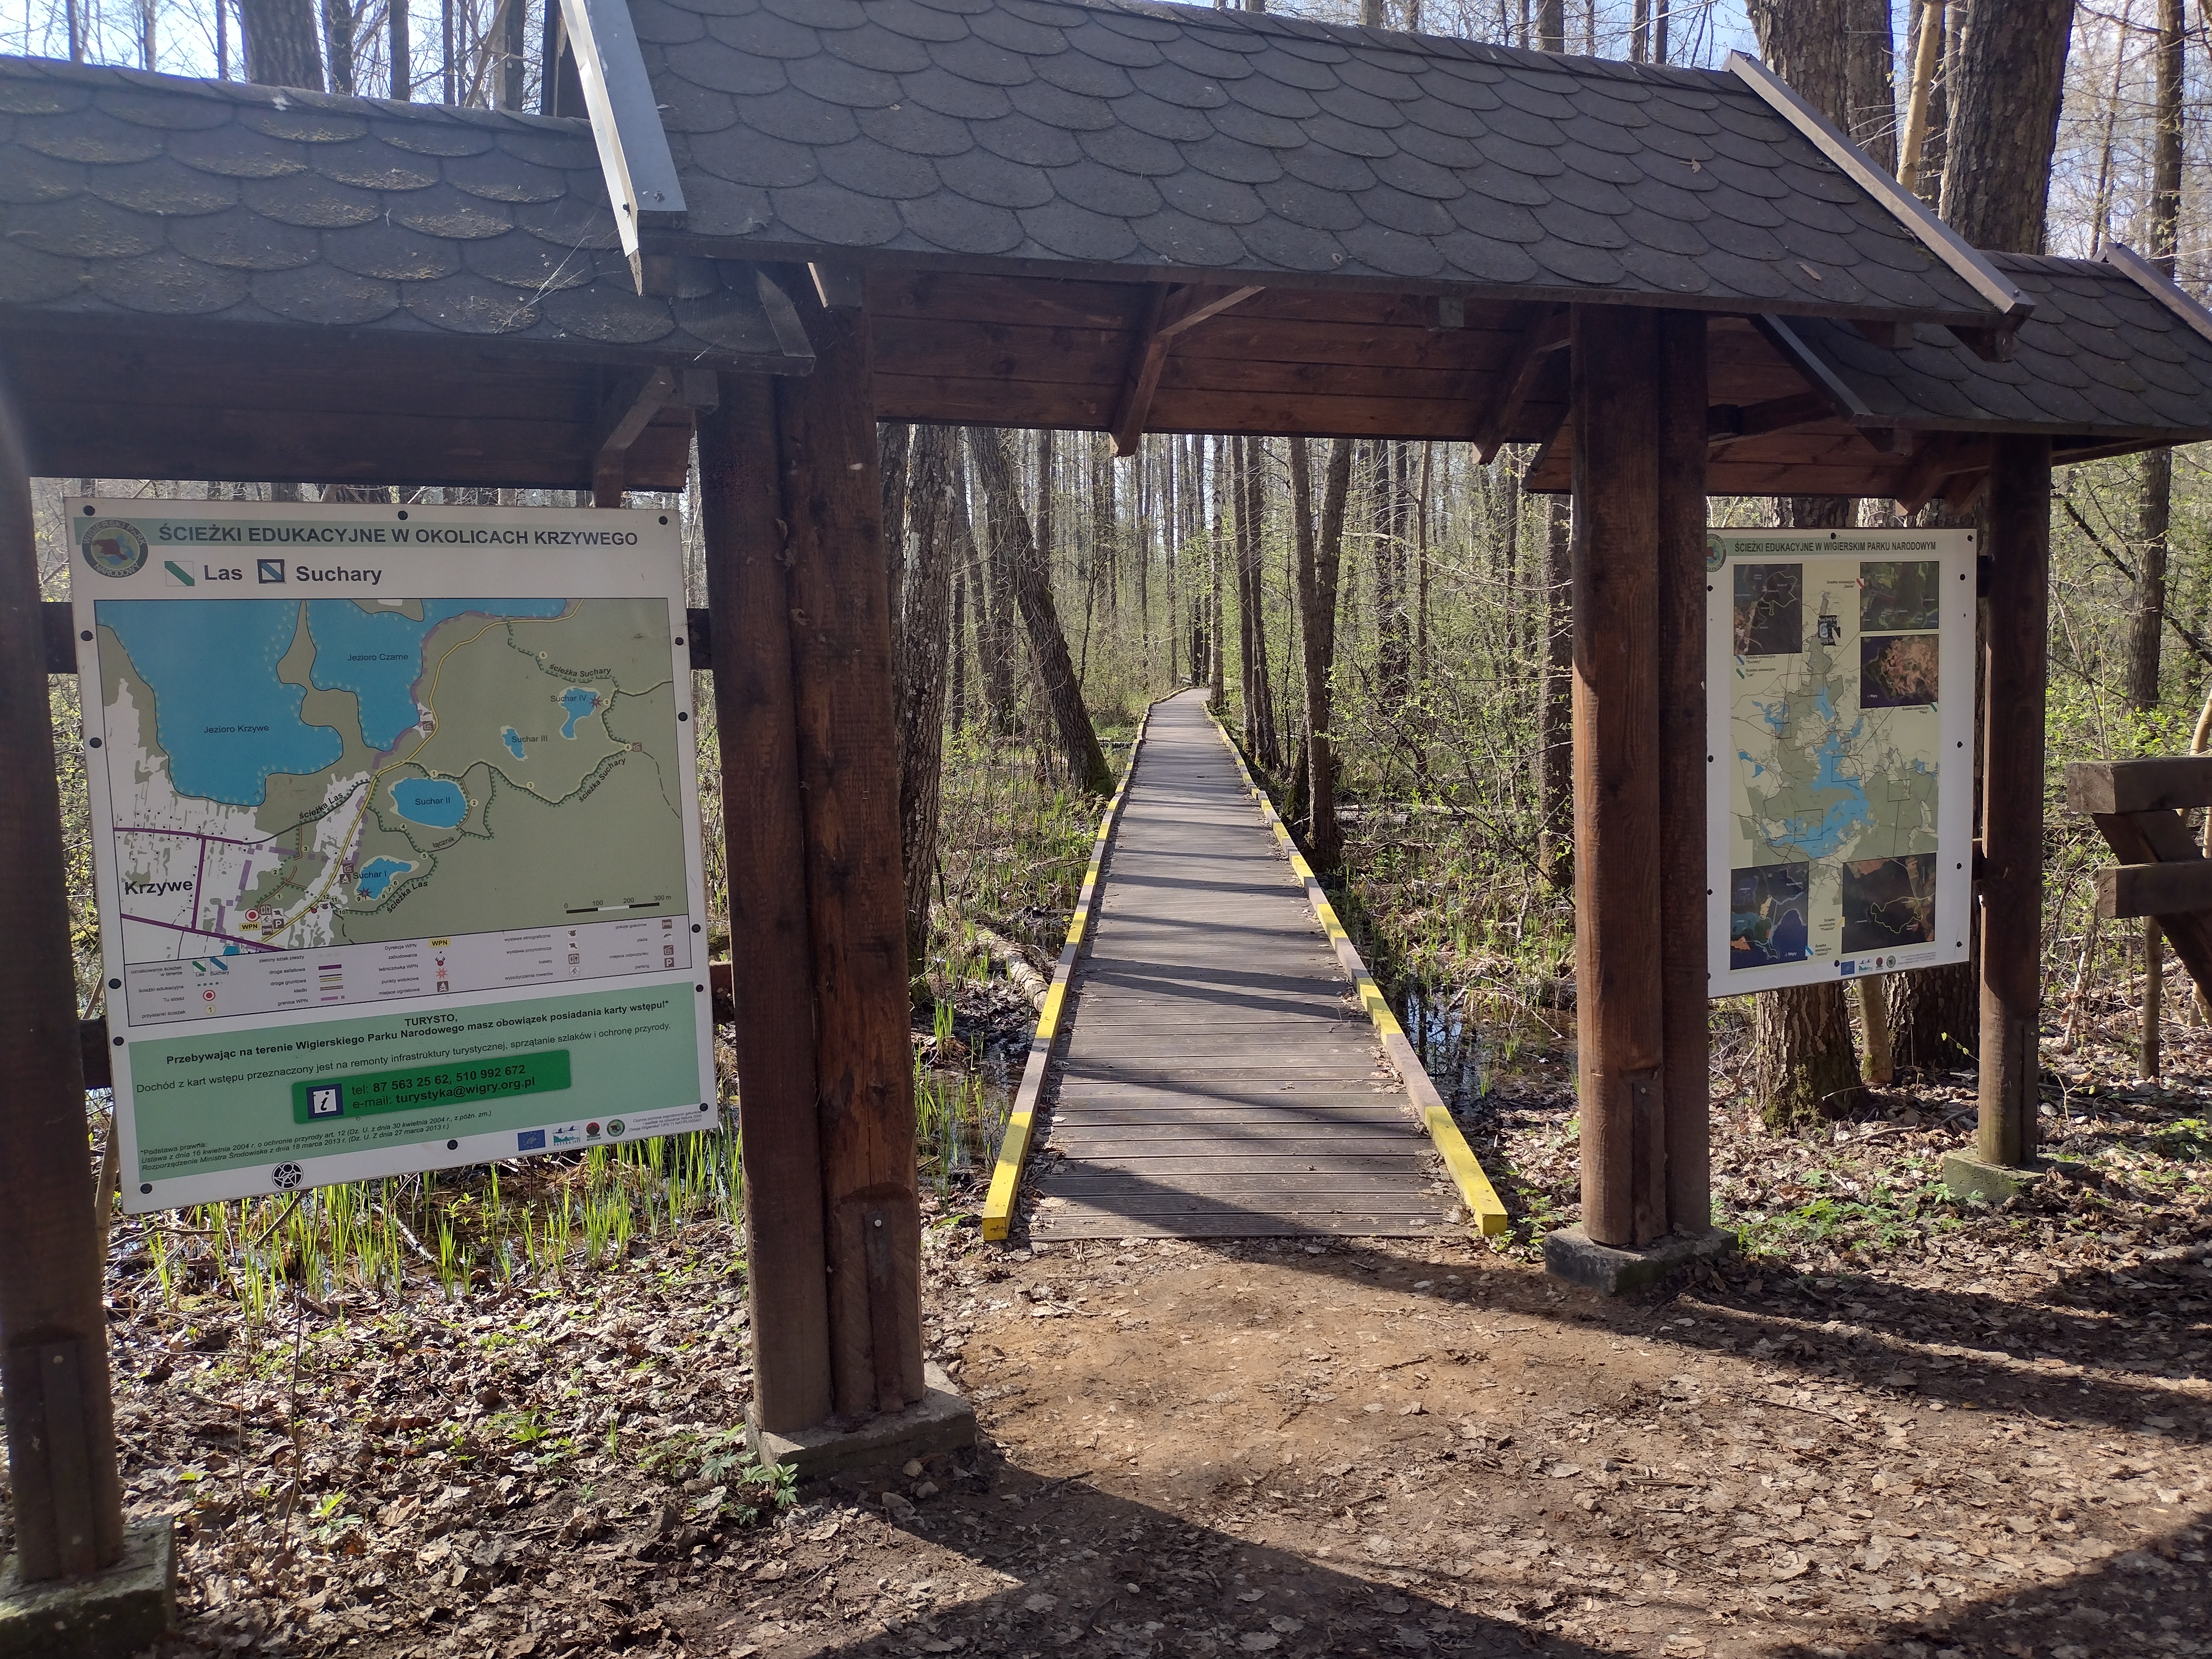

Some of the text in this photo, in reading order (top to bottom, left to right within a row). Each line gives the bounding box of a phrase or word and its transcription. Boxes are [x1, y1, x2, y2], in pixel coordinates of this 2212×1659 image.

[83, 520, 146, 545] WIGIERSKI PARK
[159, 523, 639, 546] ŚCIEŻKI EDUKACYJNE W OKOLICACH KRZYWEGO
[1735, 541, 1936, 552] ŚCIEŻKI EDUKACYJNE W WIGIERSKIM PARKU NARODOWYM
[93, 562, 140, 577] NARODOWY
[204, 564, 243, 581] Las
[296, 566, 382, 585] Suchary
[549, 664, 612, 677] ścieżka Suchary
[204, 724, 269, 734] Jezioro Krzywe
[579, 758, 626, 803] ścieżka Suchary
[299, 792, 343, 819] ścieżka Las
[432, 836, 455, 848] łącznik
[353, 870, 383, 879] Suchar
[124, 880, 193, 896] Krzywe
[387, 881, 429, 913] ścieżka Las
[404, 1013, 458, 1027] TURYSTO,
[166, 1050, 237, 1065] Przebywając
[255, 1043, 293, 1055] terenie
[295, 1035, 365, 1051] Wigierskiego
[367, 1031, 398, 1042] Parku
[400, 1024, 465, 1039] Narodowego
[467, 1021, 493, 1031] masz
[495, 1014, 548, 1027] obowiązek
[550, 1008, 602, 1023] posiadania
[604, 1005, 627, 1015] karty
[136, 1080, 176, 1093] Dochód
[187, 1078, 206, 1087] kart
[208, 1073, 244, 1084] wstępu
[247, 1065, 314, 1082] przeznaczony
[316, 1062, 334, 1073] jest
[336, 1061, 348, 1070] na
[351, 1056, 388, 1068] remonty
[390, 1048, 451, 1063] infrastruktury
[452, 1041, 508, 1056] turystycznej,
[510, 1035, 555, 1048] sprzątanie
[557, 1031, 592, 1043] szlaków
[598, 1027, 632, 1038] ochronę
[634, 1022, 671, 1035] przyrody.
[351, 1065, 526, 1095] tel: 87 563 25 62, 510 992 672
[352, 1076, 536, 1109] e-mail: turystyka@wigry.org.pl
[141, 1155, 167, 1164] Ustawa
[202, 1146, 231, 1155] kwietnia
[264, 1138, 293, 1147] ochronie
[294, 1133, 324, 1143] przyrody
[402, 1119, 428, 1128] kwietnia
[459, 1113, 477, 1121] późn.
[180, 1141, 208, 1152] prawna:
[141, 1159, 199, 1171] Rozporządzenie
[200, 1155, 227, 1164] Ministra
[229, 1149, 268, 1159] Środowiska
[348, 1135, 362, 1144] (Dz.
